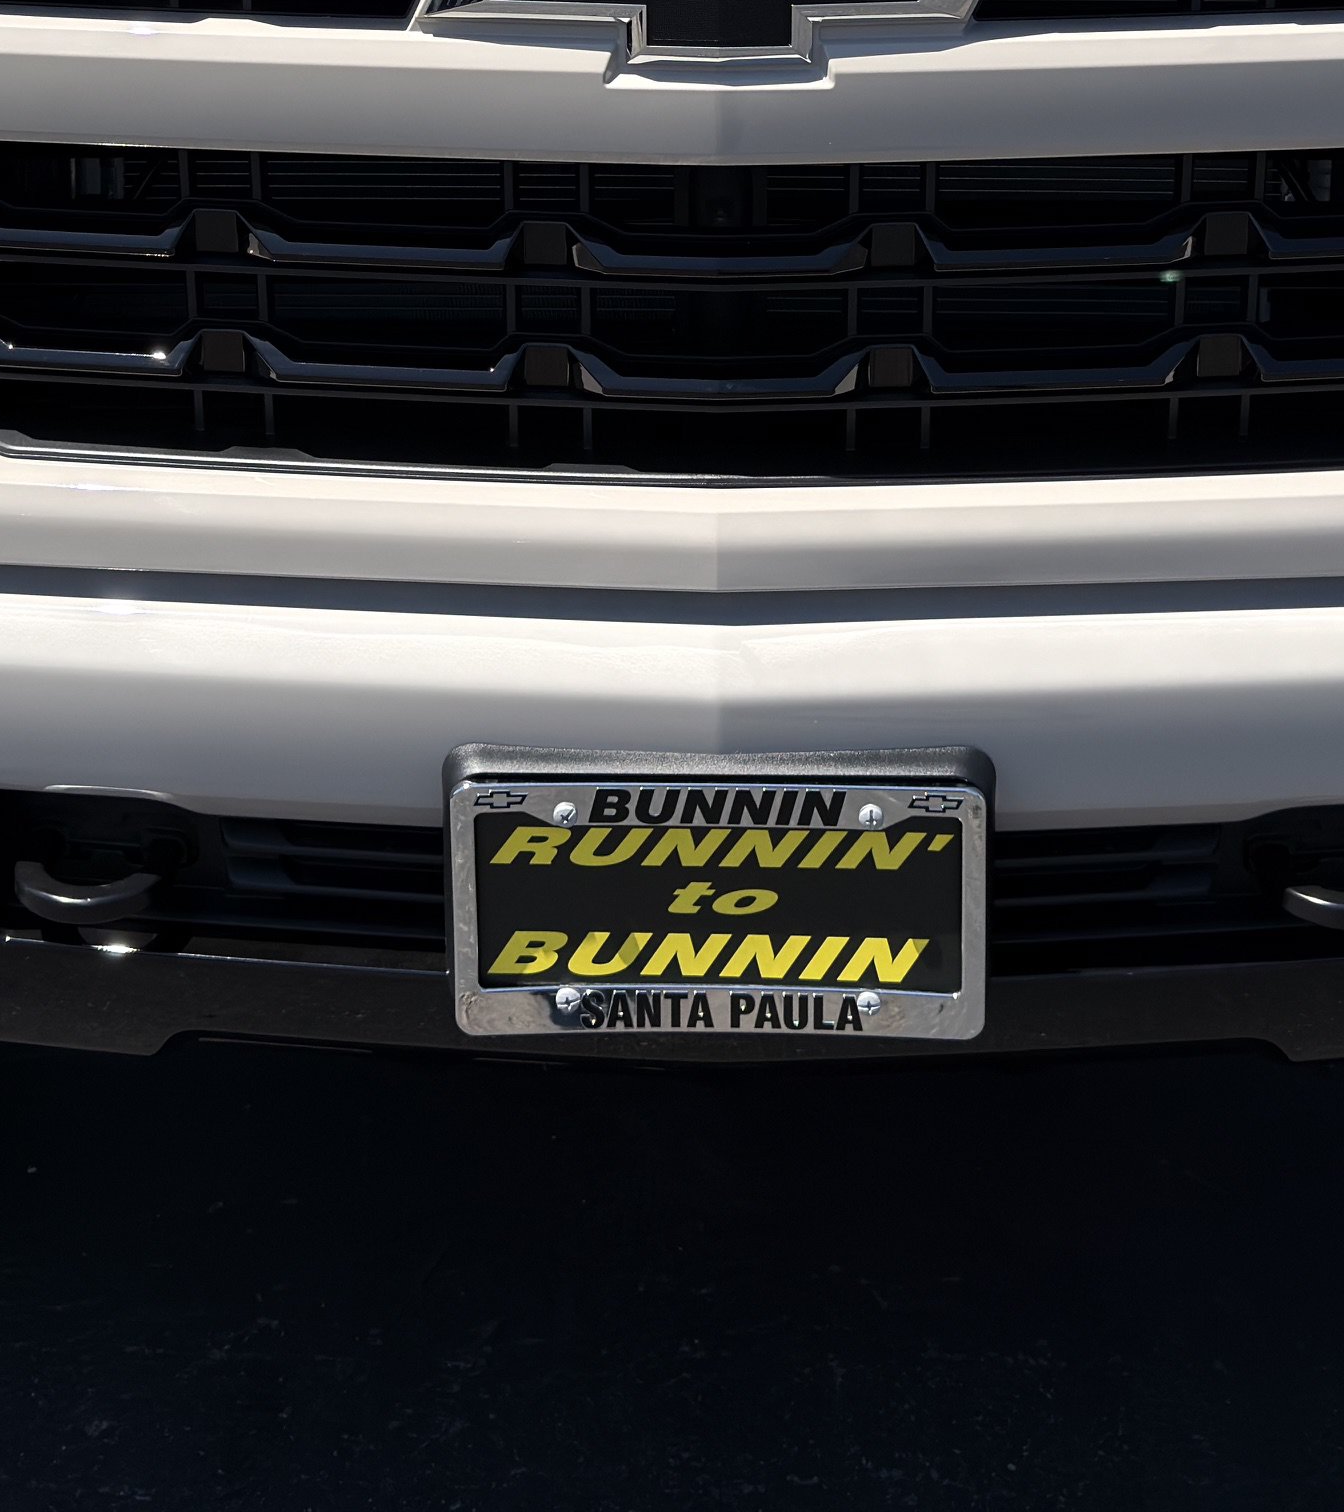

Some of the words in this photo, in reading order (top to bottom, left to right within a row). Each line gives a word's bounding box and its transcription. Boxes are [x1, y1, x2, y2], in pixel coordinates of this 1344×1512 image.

[589, 789, 846, 826] BUNNIN
[489, 826, 954, 870] RUNNIN'
[667, 881, 779, 915] to
[487, 930, 930, 983] BUNNIN
[578, 990, 714, 1030] SANTA
[729, 990, 863, 1031] PAULA
